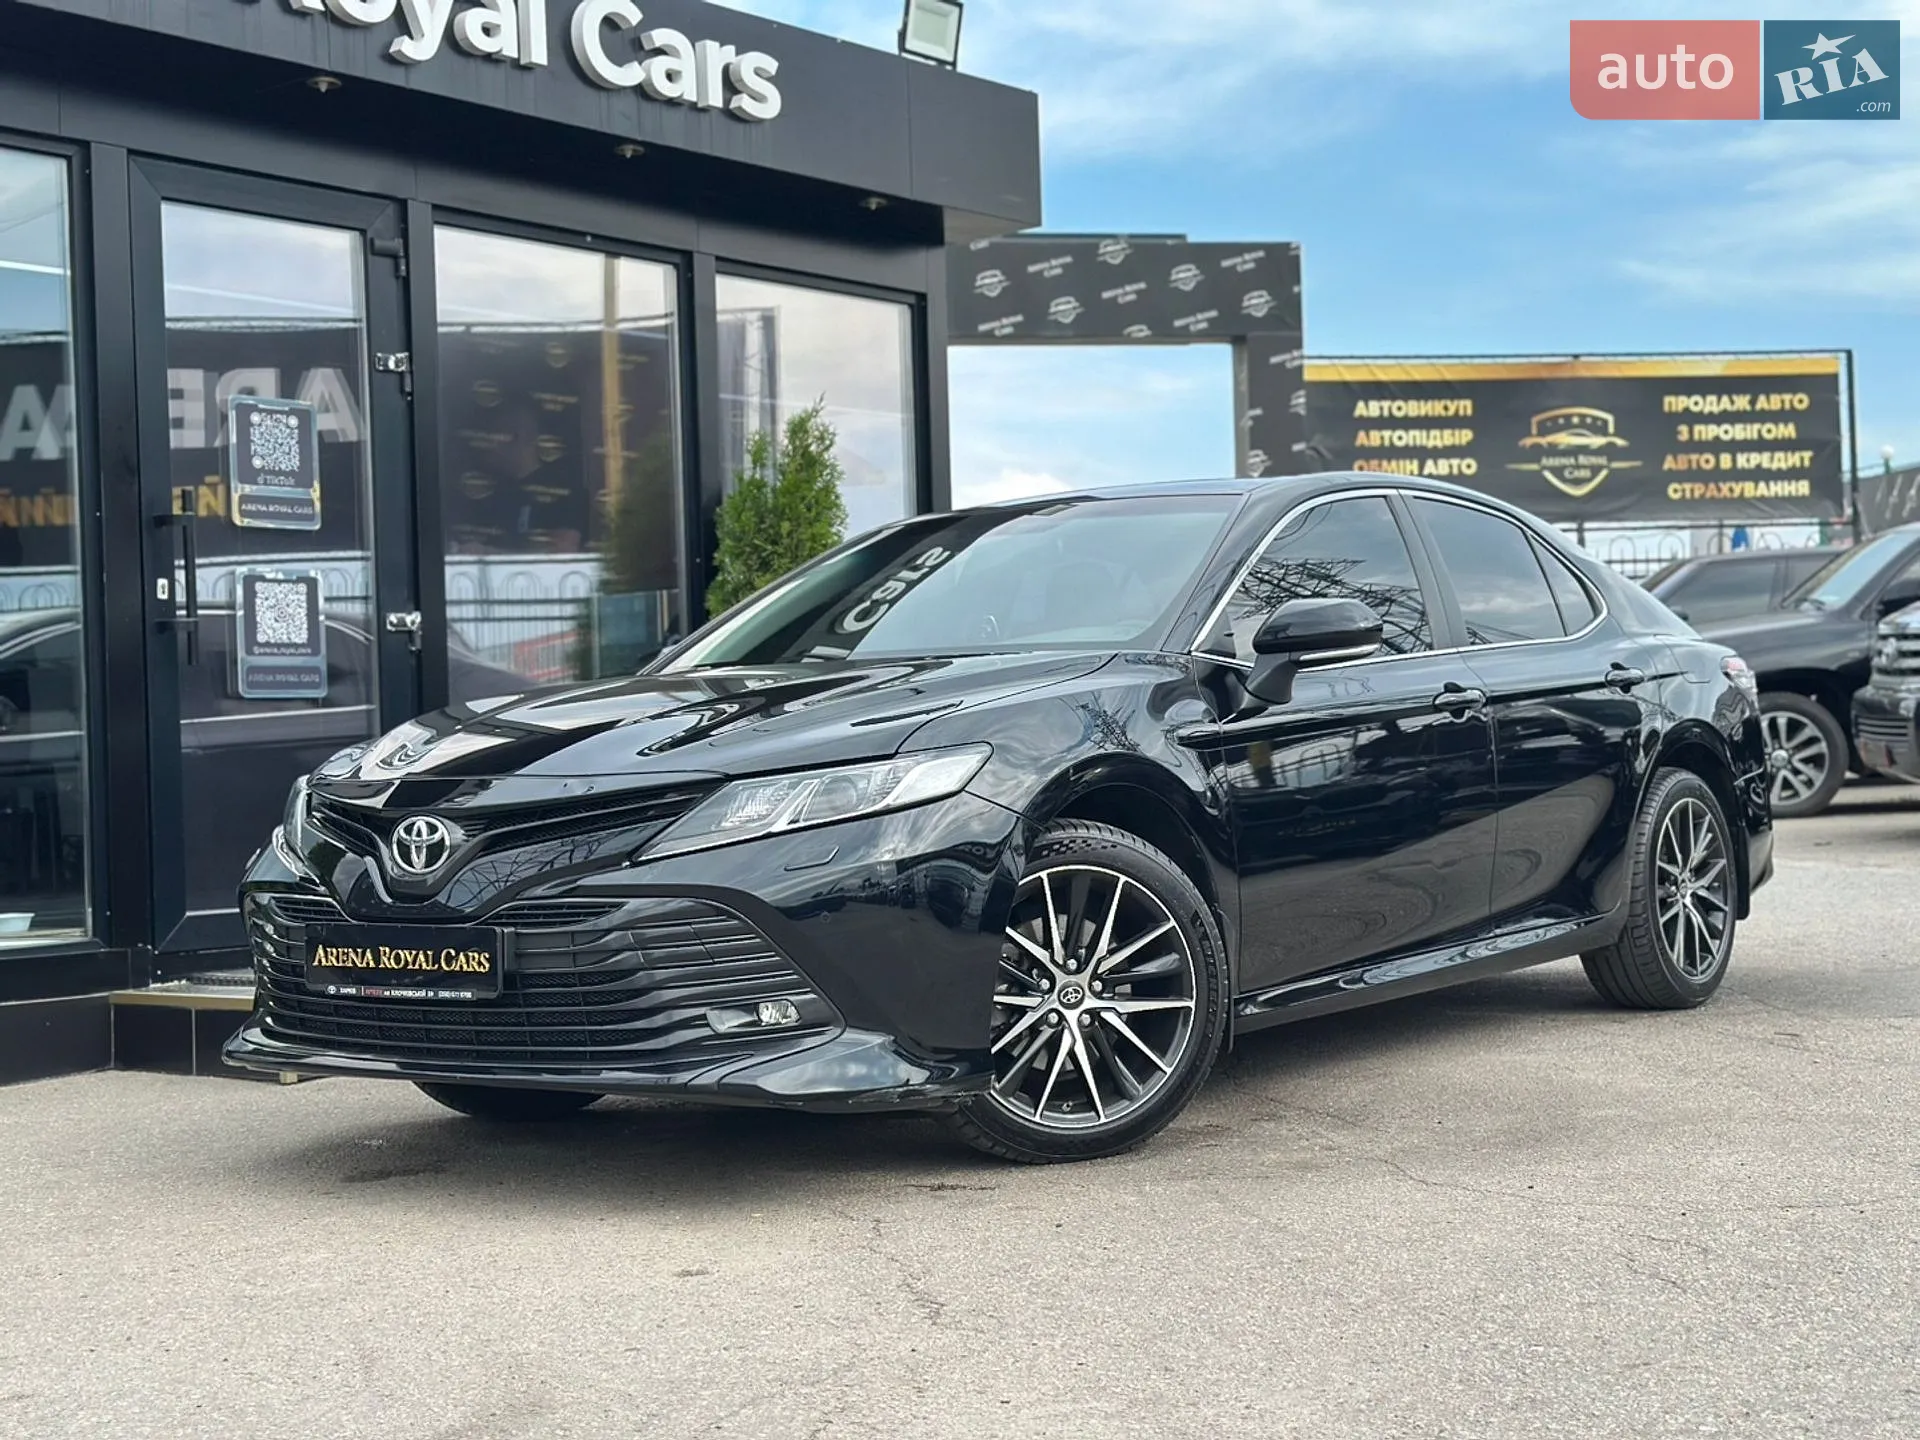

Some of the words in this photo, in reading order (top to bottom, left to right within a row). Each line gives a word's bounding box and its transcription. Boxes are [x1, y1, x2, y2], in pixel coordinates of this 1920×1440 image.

[571, 0, 781, 120] Cars
[1353, 399, 1473, 418] АВТОВИКУП
[1663, 394, 1751, 414] ПРОДАЖ
[1755, 393, 1810, 411] АВТО
[1355, 428, 1474, 448] АВТОПІДБІР
[1693, 422, 1797, 441] ПРОБІГОМ
[1423, 458, 1478, 475] АВТО
[1662, 453, 1716, 471] АВТО
[1719, 452, 1732, 470] В
[1736, 450, 1814, 470] КРЕДИТ
[1667, 479, 1811, 499] СТРАХУВАННЯ
[312, 944, 376, 968] ARENA
[378, 945, 438, 971] ROYAL
[440, 948, 490, 973] CARS
